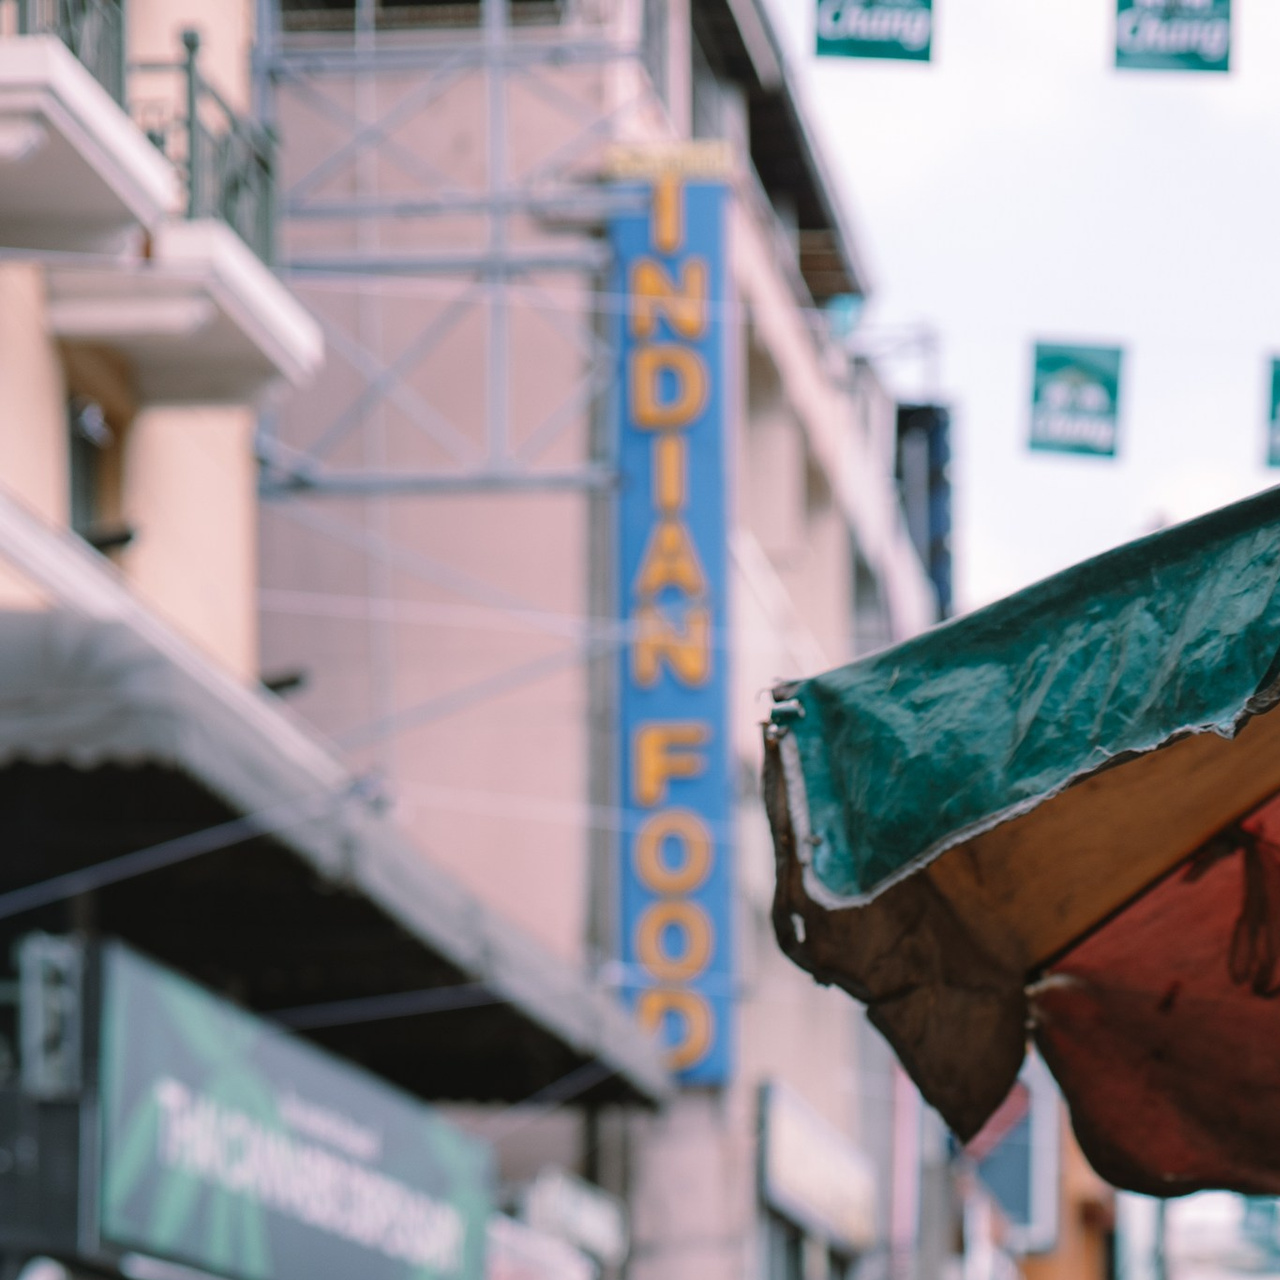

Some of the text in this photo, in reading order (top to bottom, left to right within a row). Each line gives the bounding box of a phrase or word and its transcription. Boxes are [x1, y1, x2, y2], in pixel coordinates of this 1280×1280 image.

[818, 0, 931, 51] Chang
[1117, 9, 1229, 62] Chang
[630, 172, 712, 689] INDIAN
[633, 723, 715, 1071] FOOD
